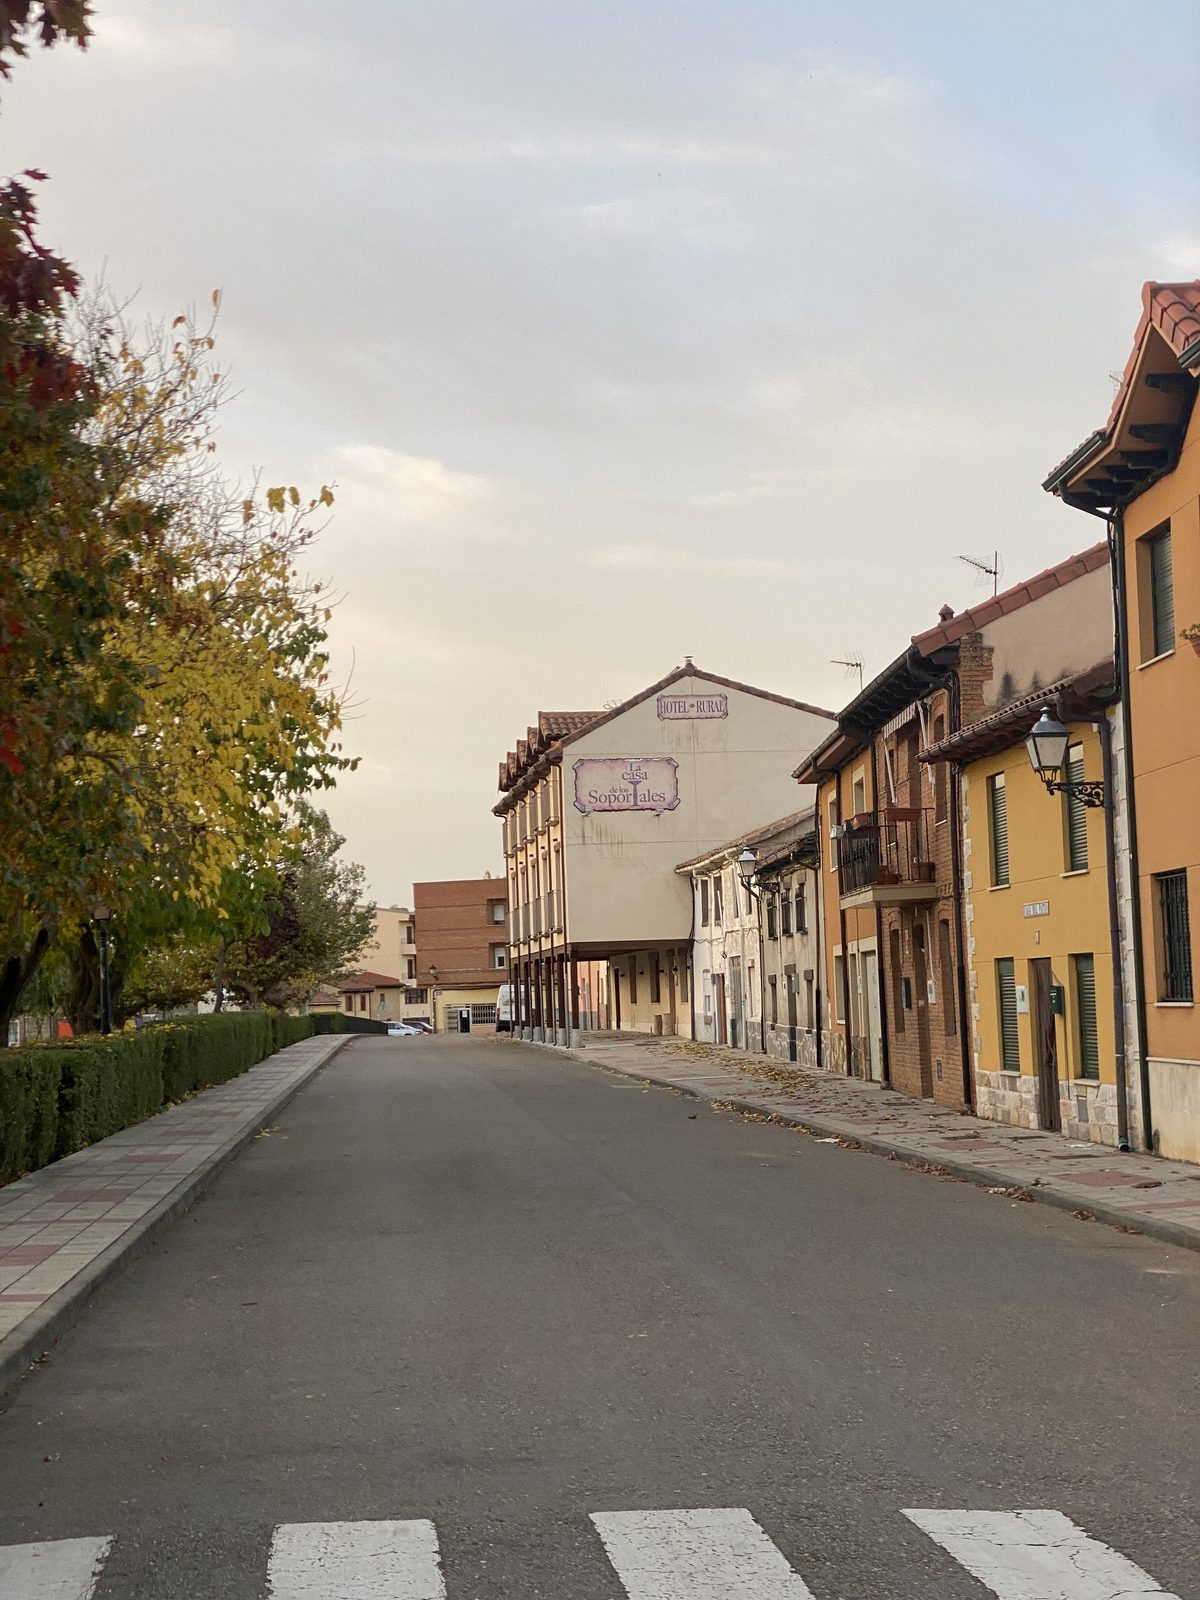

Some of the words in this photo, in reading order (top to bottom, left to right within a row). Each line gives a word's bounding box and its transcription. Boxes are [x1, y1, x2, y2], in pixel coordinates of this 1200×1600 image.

[660, 700, 689, 714] HOTEL
[696, 700, 724, 713] RURAL
[629, 762, 641, 771] La
[621, 771, 648, 781] casa
